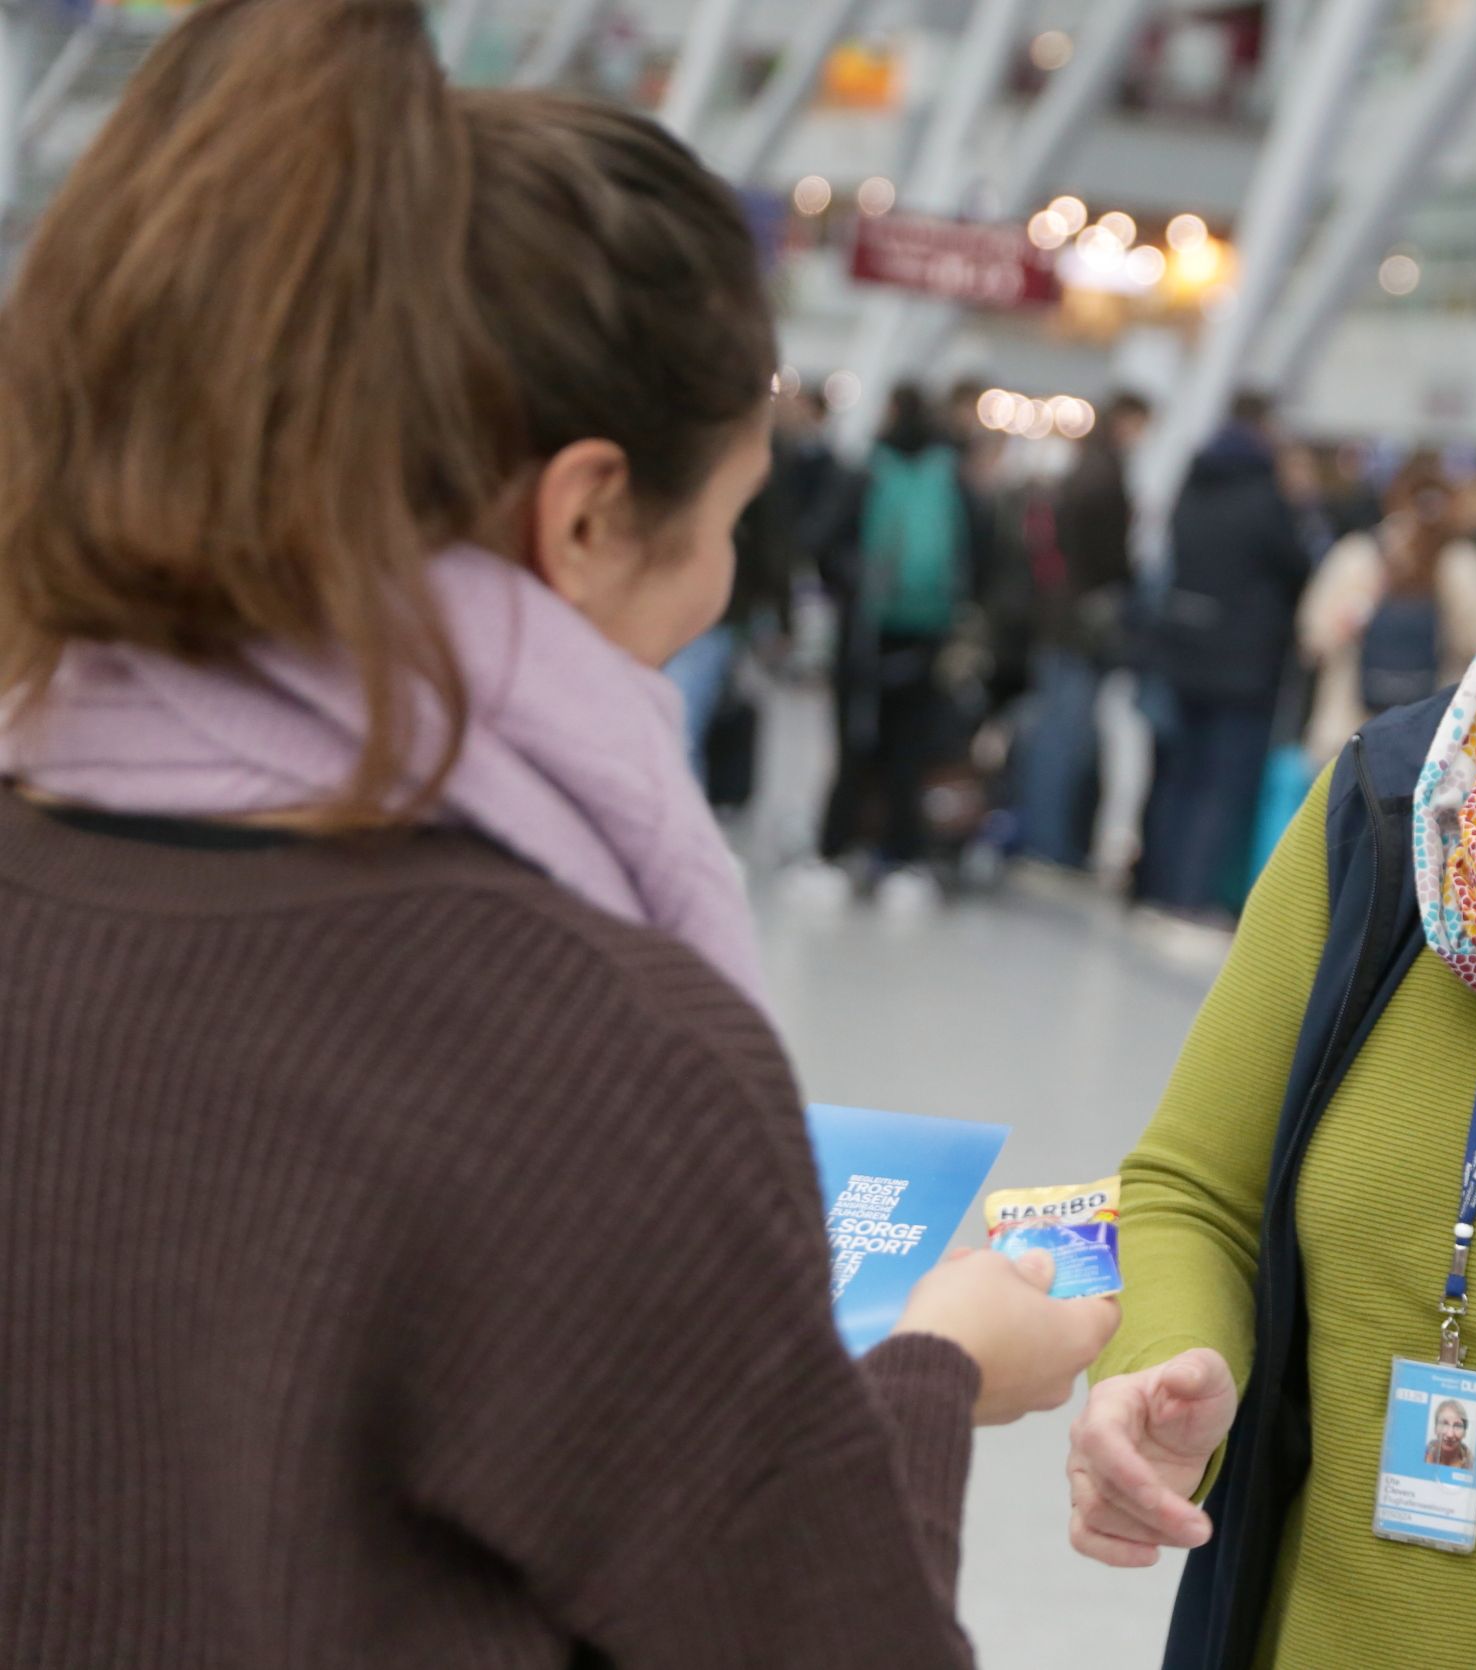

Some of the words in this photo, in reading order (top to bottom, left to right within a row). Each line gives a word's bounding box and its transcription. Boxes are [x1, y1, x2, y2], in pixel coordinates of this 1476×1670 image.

[847, 1181, 906, 1197] TROST
[838, 1191, 900, 1207] DASEIN
[1001, 1192, 1107, 1220] HARIBO
